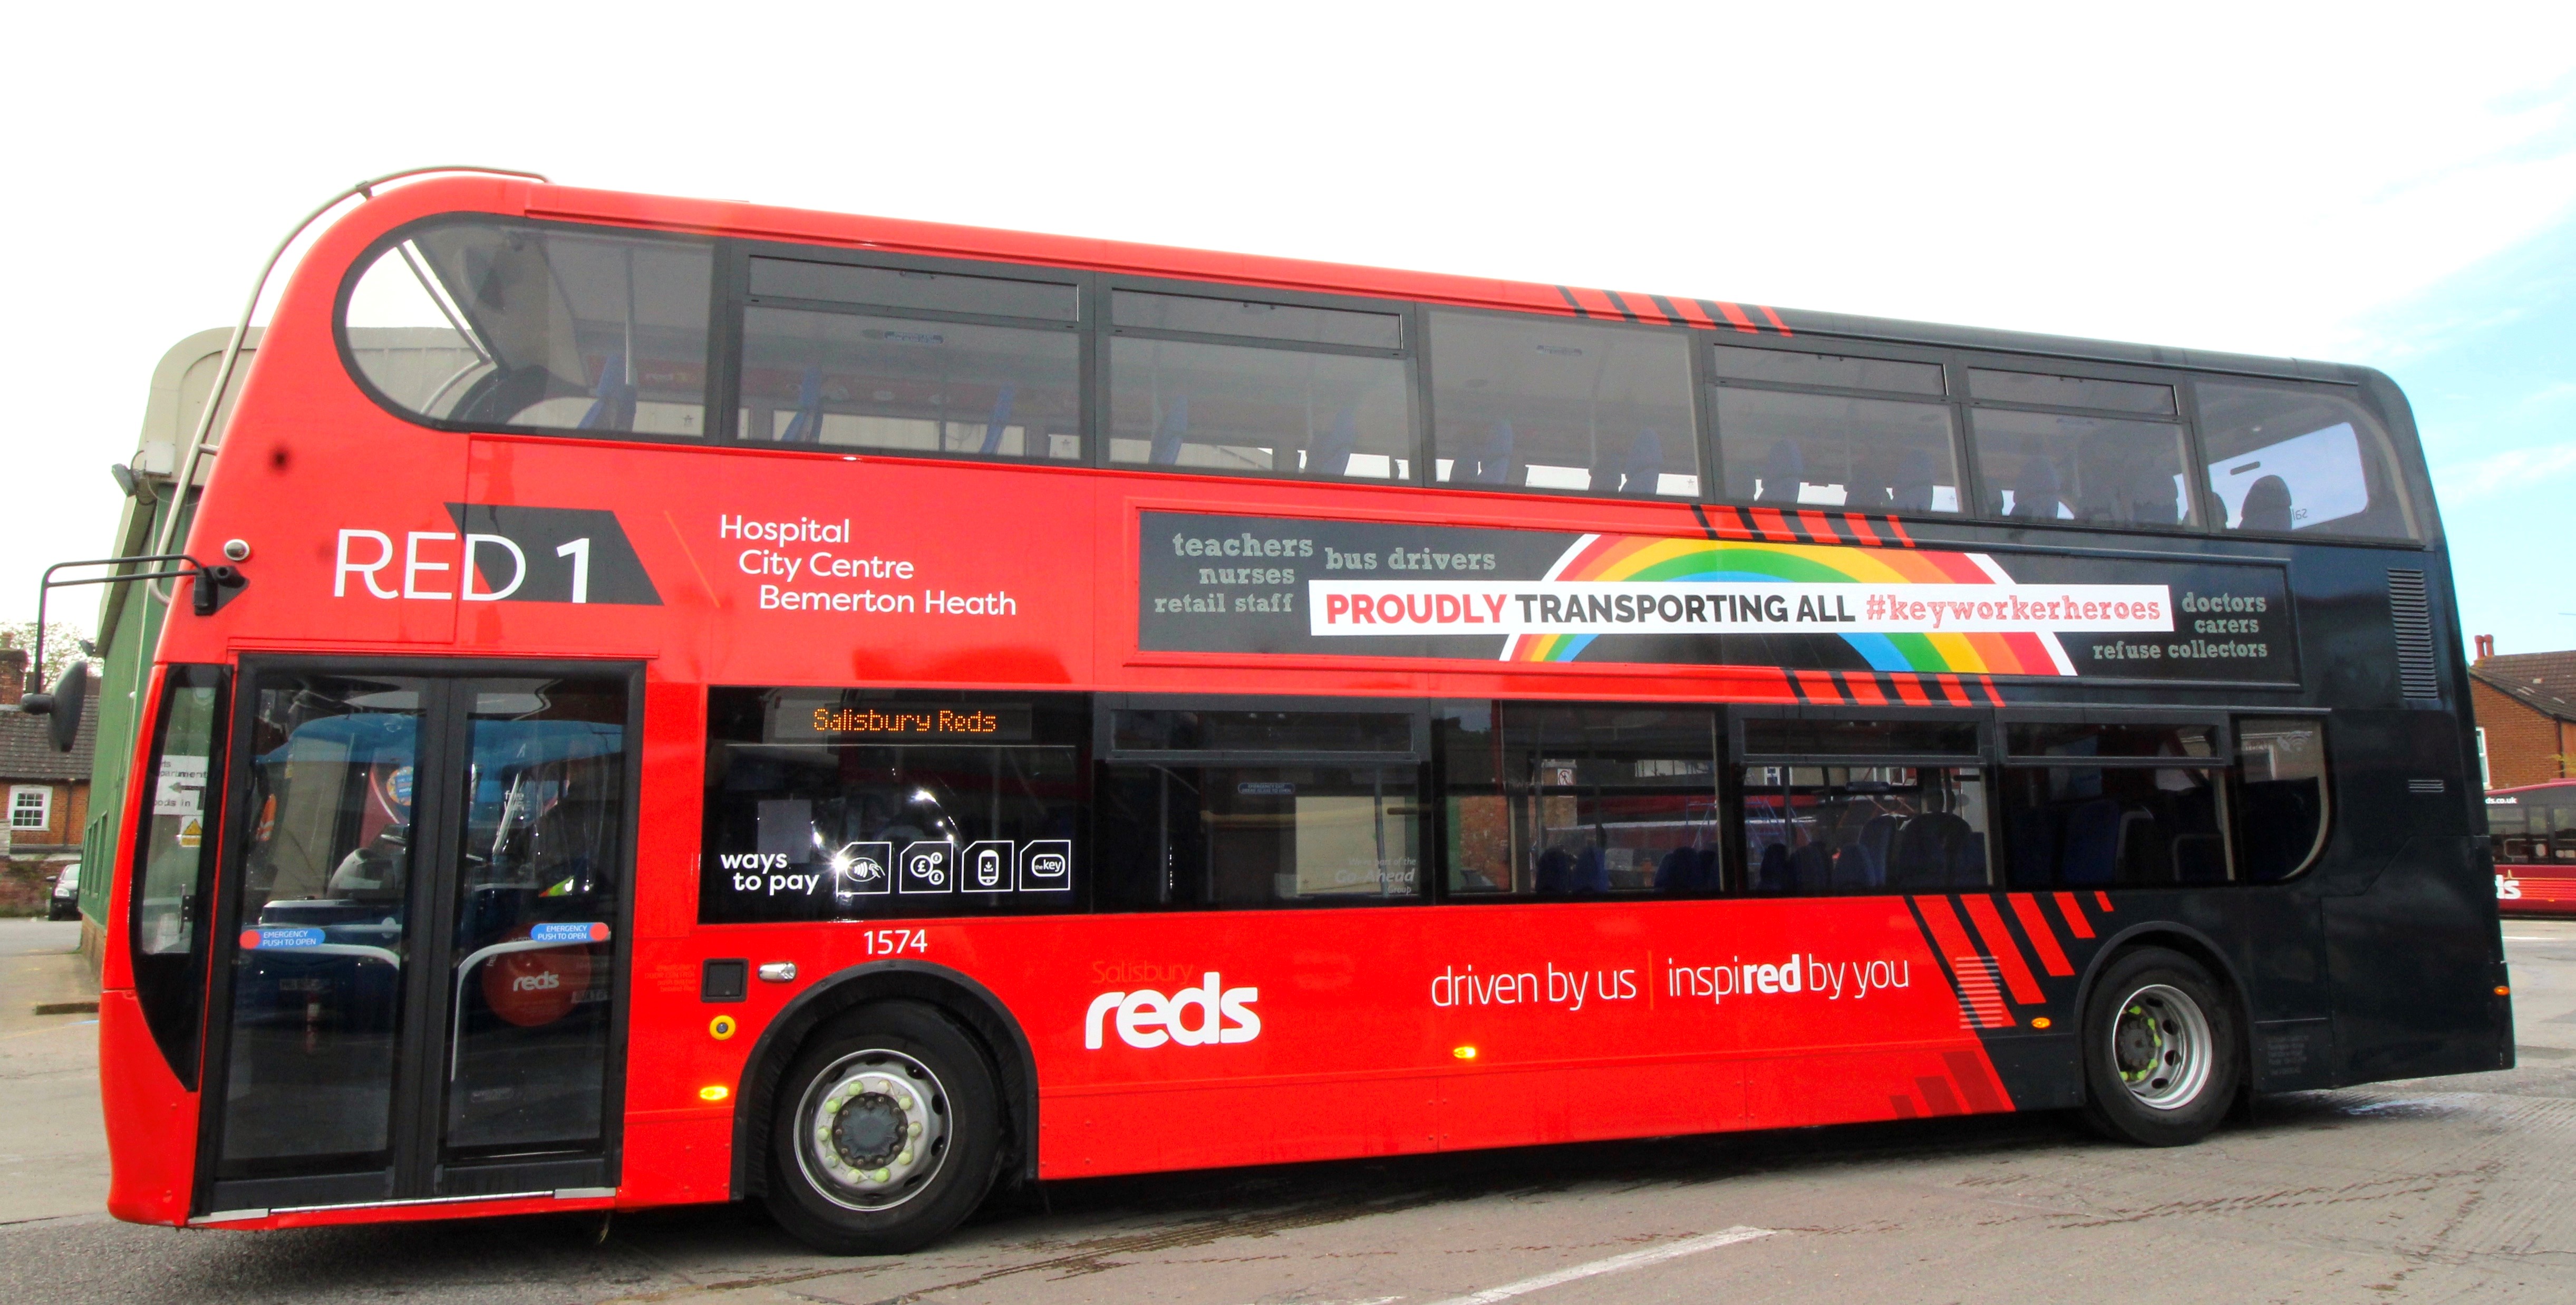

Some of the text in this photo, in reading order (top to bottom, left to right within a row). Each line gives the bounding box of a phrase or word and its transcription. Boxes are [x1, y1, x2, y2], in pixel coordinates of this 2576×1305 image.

[720, 514, 850, 547] Hospital
[1173, 533, 1313, 557] teachers
[334, 528, 590, 604] RED 1
[739, 549, 914, 582] City Centre
[1325, 547, 1496, 571] bus drivers
[1199, 567, 1295, 585] nurses
[760, 584, 1016, 616] Bemerton Heath
[1155, 593, 1294, 613] retail staff
[1326, 593, 2161, 628] PROUDLY TRANSPORTING ALL #keyworkerheroes
[2182, 592, 2267, 613] doctors
[2194, 617, 2259, 634] carers
[2093, 639, 2268, 660] refuse collectors
[814, 709, 996, 732] Salisbury Reds
[2485, 796, 2517, 805] ds.co.uk
[721, 853, 787, 879] ways
[1043, 859, 1061, 872] key
[1403, 857, 1417, 866] the
[733, 872, 819, 895] to pay
[1335, 868, 1416, 883] Go-Ahead
[1388, 886, 1412, 895] Group
[864, 930, 928, 954] 1574
[513, 971, 559, 992] reds
[1092, 960, 1195, 984] Salisbury
[1431, 953, 1909, 1011] driven by us inspired by you
[1085, 971, 1261, 1050] reds
